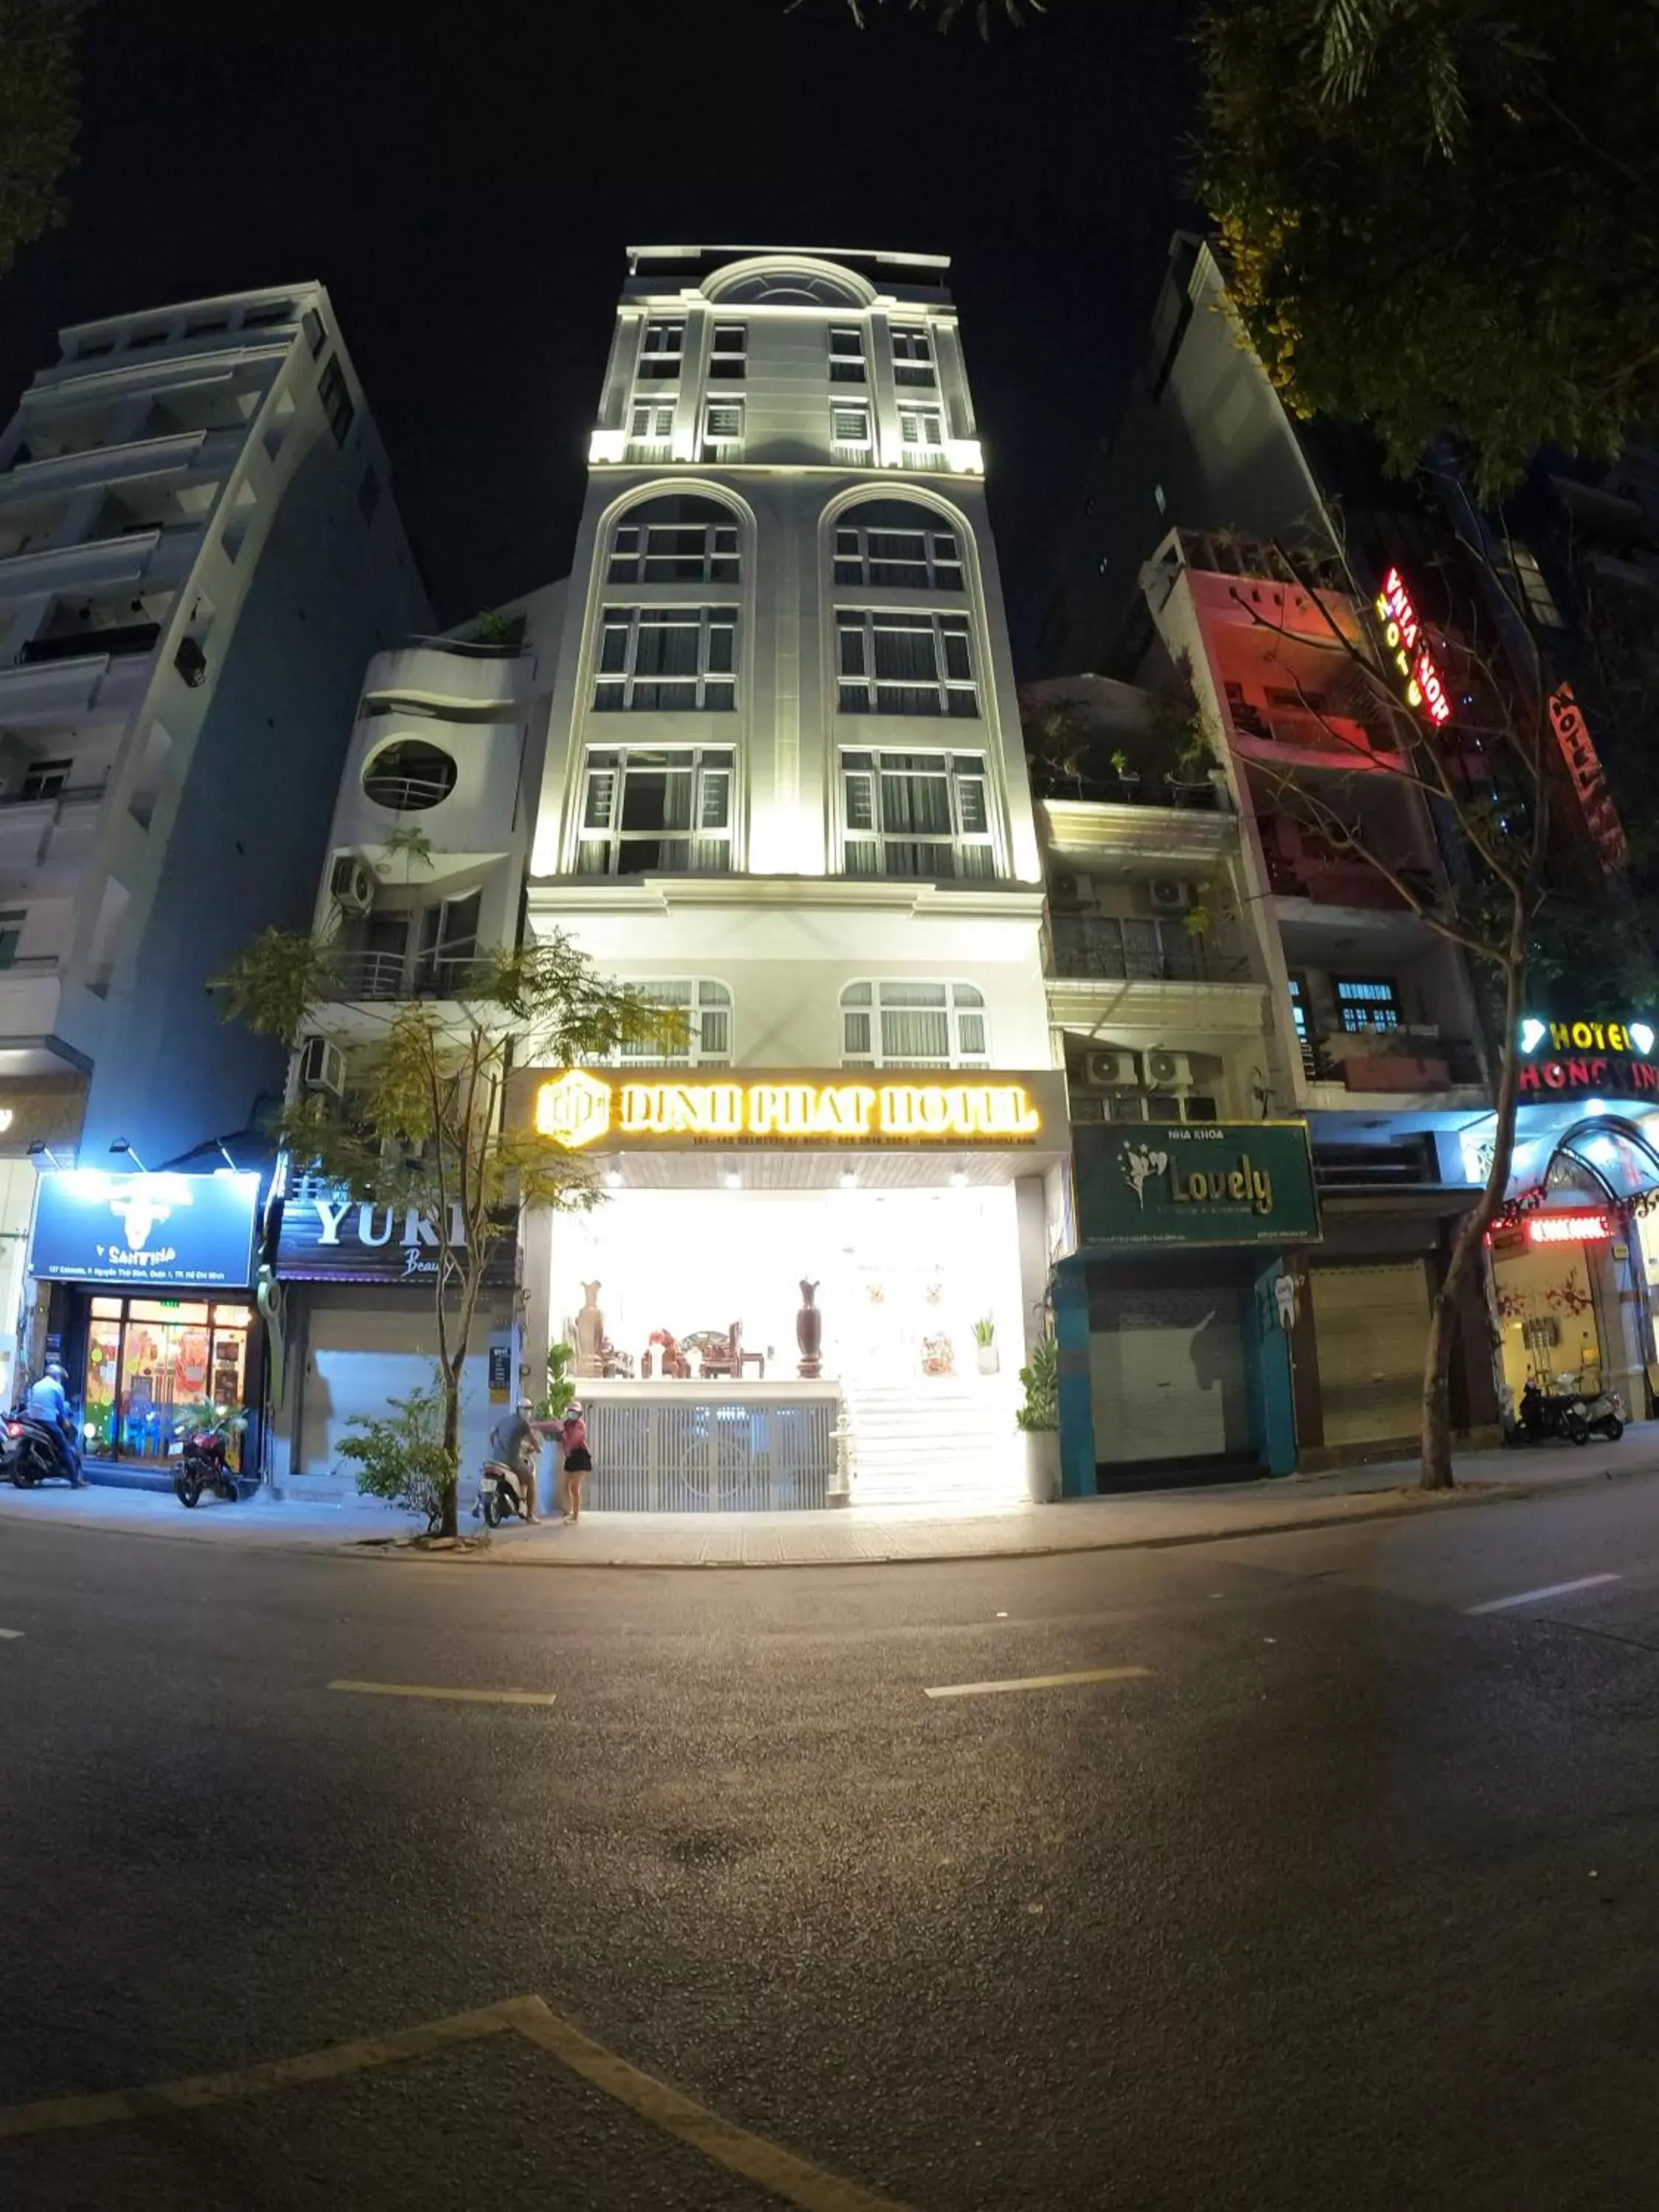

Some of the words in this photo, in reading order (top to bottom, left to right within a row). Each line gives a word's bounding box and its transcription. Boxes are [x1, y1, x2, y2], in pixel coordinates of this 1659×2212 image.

[1549, 1021, 1632, 1051] HOTEL
[880, 1085, 1040, 1134] HOTEL
[1169, 1153, 1273, 1214] Lovely
